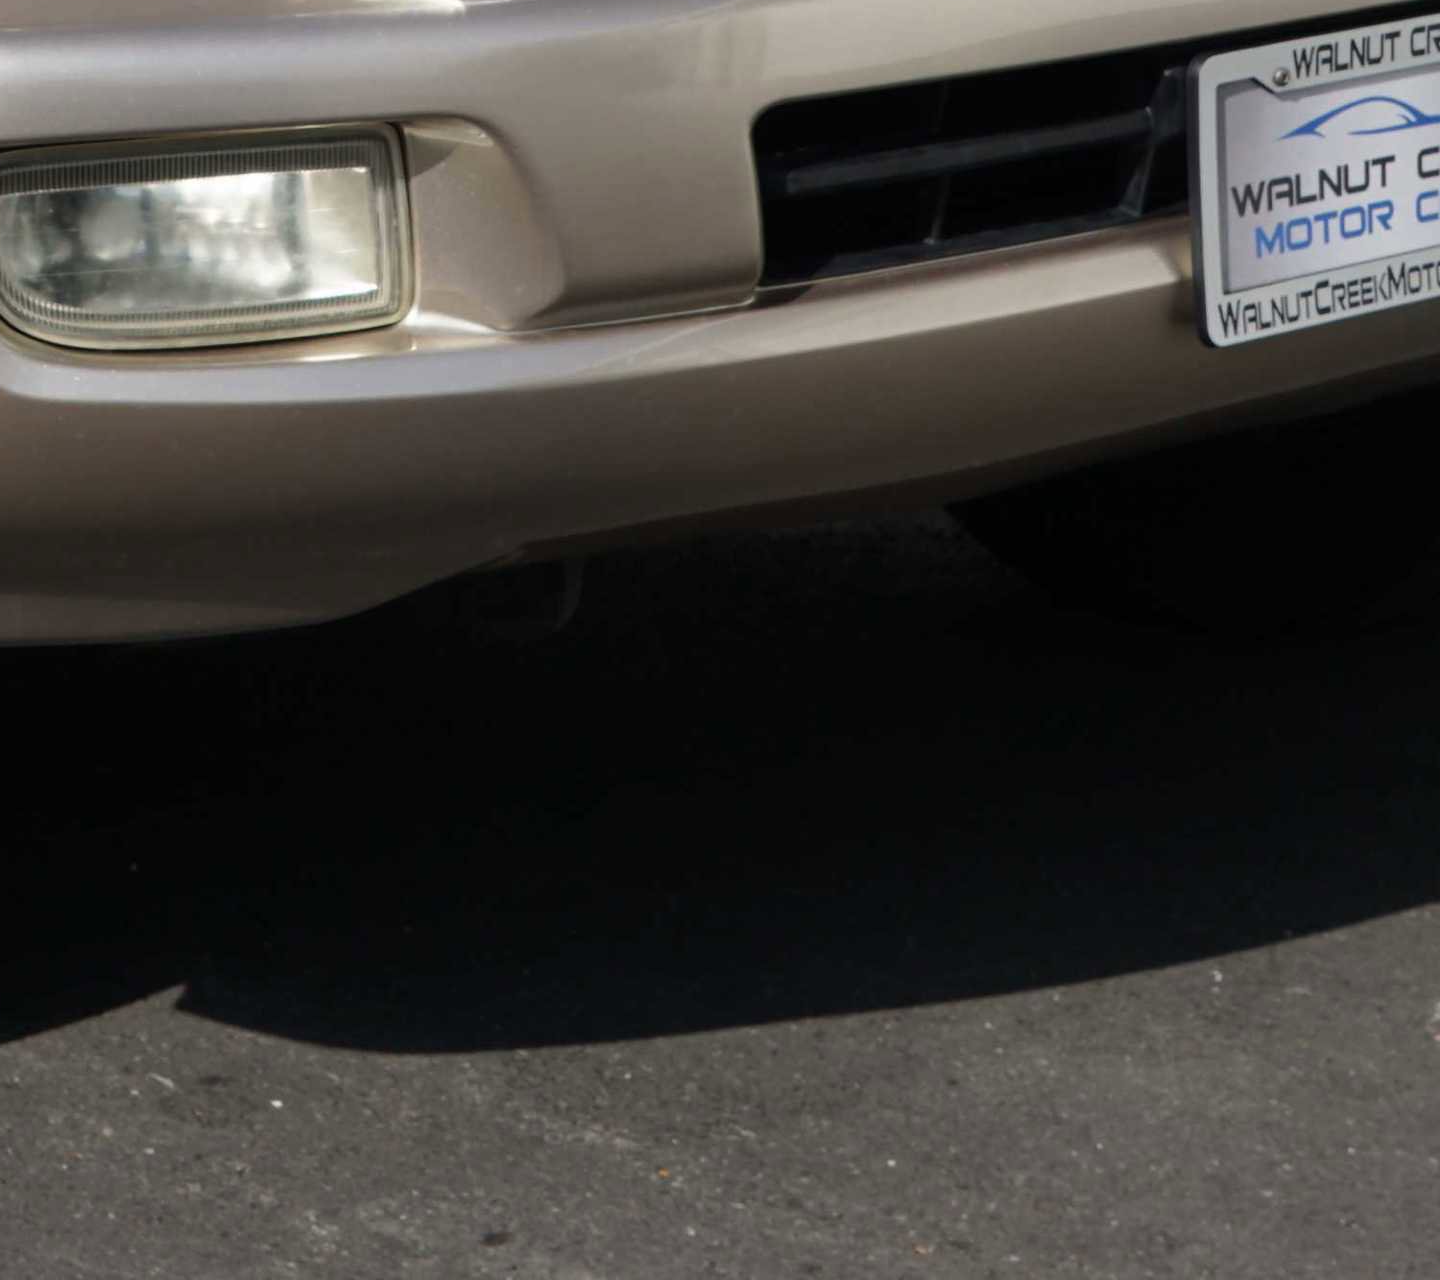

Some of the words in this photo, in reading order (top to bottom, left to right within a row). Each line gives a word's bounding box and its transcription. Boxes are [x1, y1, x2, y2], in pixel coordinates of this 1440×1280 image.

[1292, 30, 1401, 79] WALNUT
[1230, 155, 1396, 218] WALNUT
[1254, 199, 1395, 259] MOTOR
